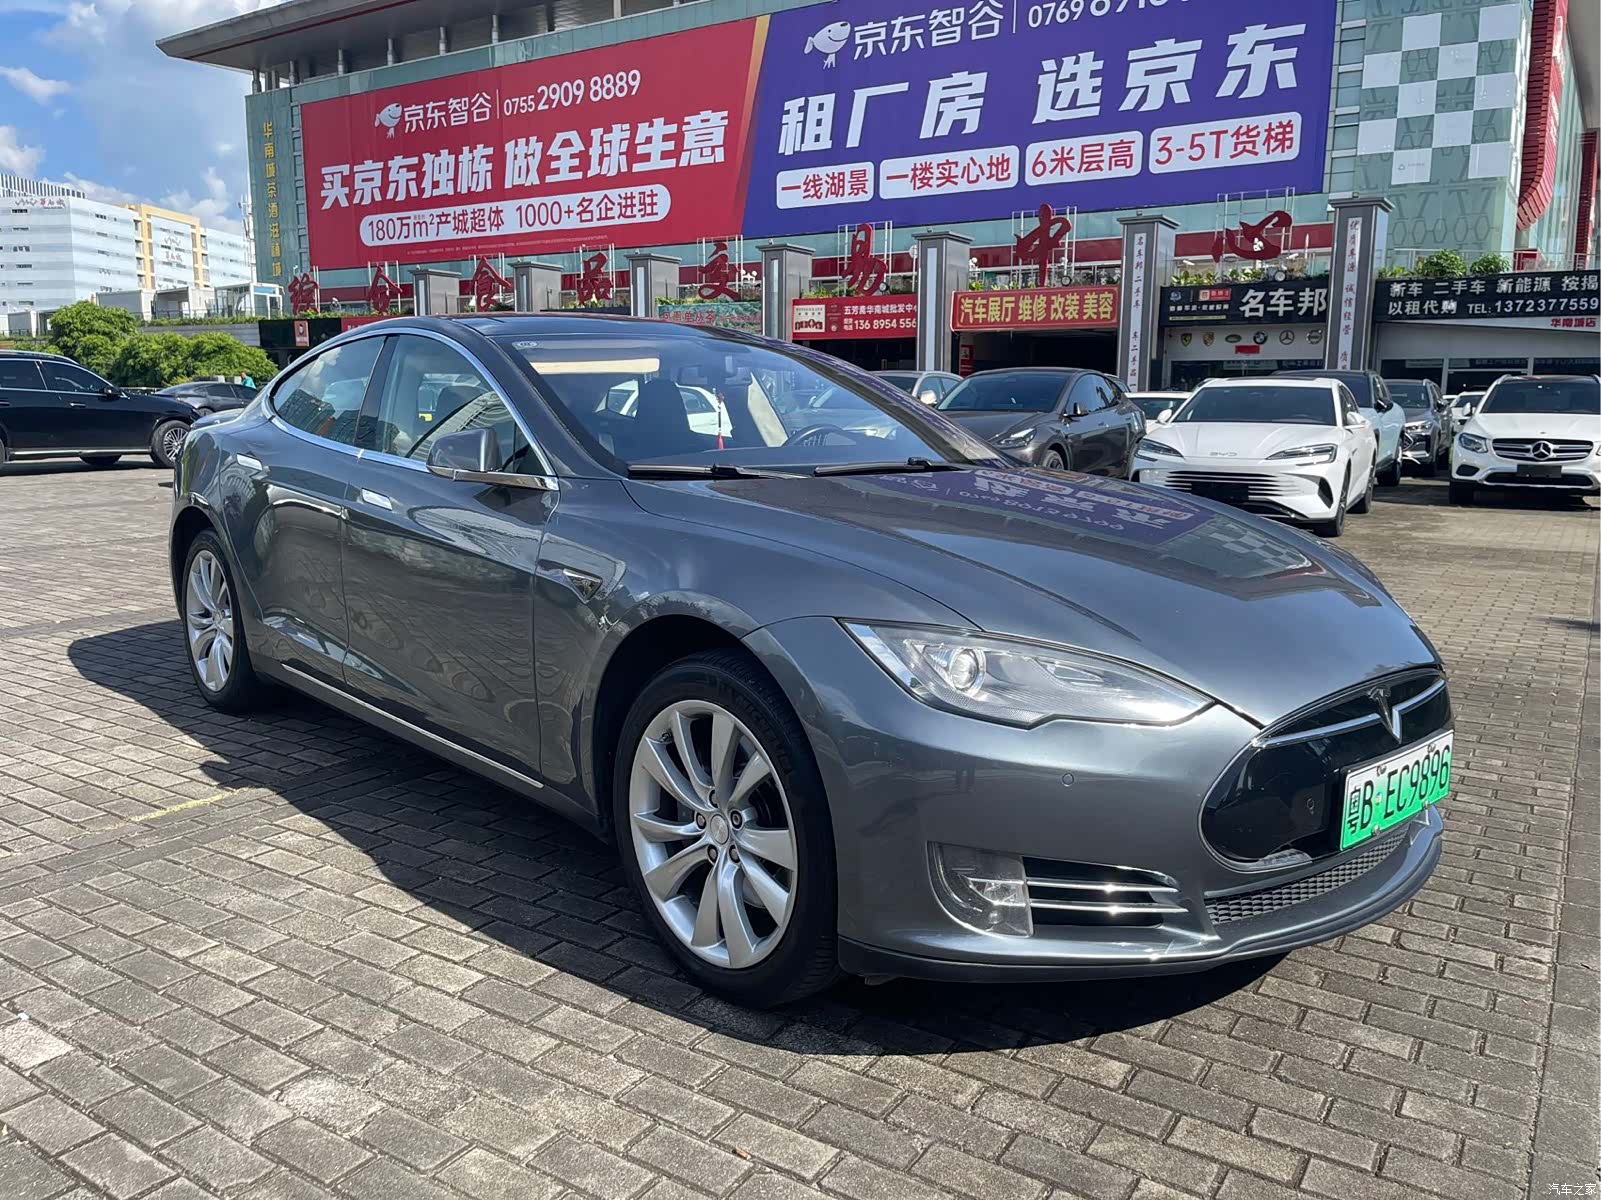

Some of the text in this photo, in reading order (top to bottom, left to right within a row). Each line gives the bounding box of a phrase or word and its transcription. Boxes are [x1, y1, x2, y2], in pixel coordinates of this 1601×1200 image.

[853, 0, 1084, 60] 京东智谷 0769
[403, 69, 641, 134] 京东智谷 0755 2909 8889
[778, 23, 1306, 156] 租厂房 选京东
[320, 109, 729, 210] 买京东独栋 做全球生意
[1031, 138, 1137, 179] 6米层高
[1154, 119, 1295, 166] 3-5T货梯
[780, 167, 870, 202] 一线湖景
[886, 153, 1012, 193] 一楼实心地
[515, 191, 659, 228] 1000+名企进驻
[1239, 287, 1328, 318] 名车邦
[1389, 275, 1599, 298] 新车 二手车 新能源 按揭
[854, 319, 871, 330] 136
[873, 318, 897, 329] 8954
[960, 291, 1114, 324] 汽车展厅 维修 改装 美容
[1388, 299, 1457, 316] 以租代购
